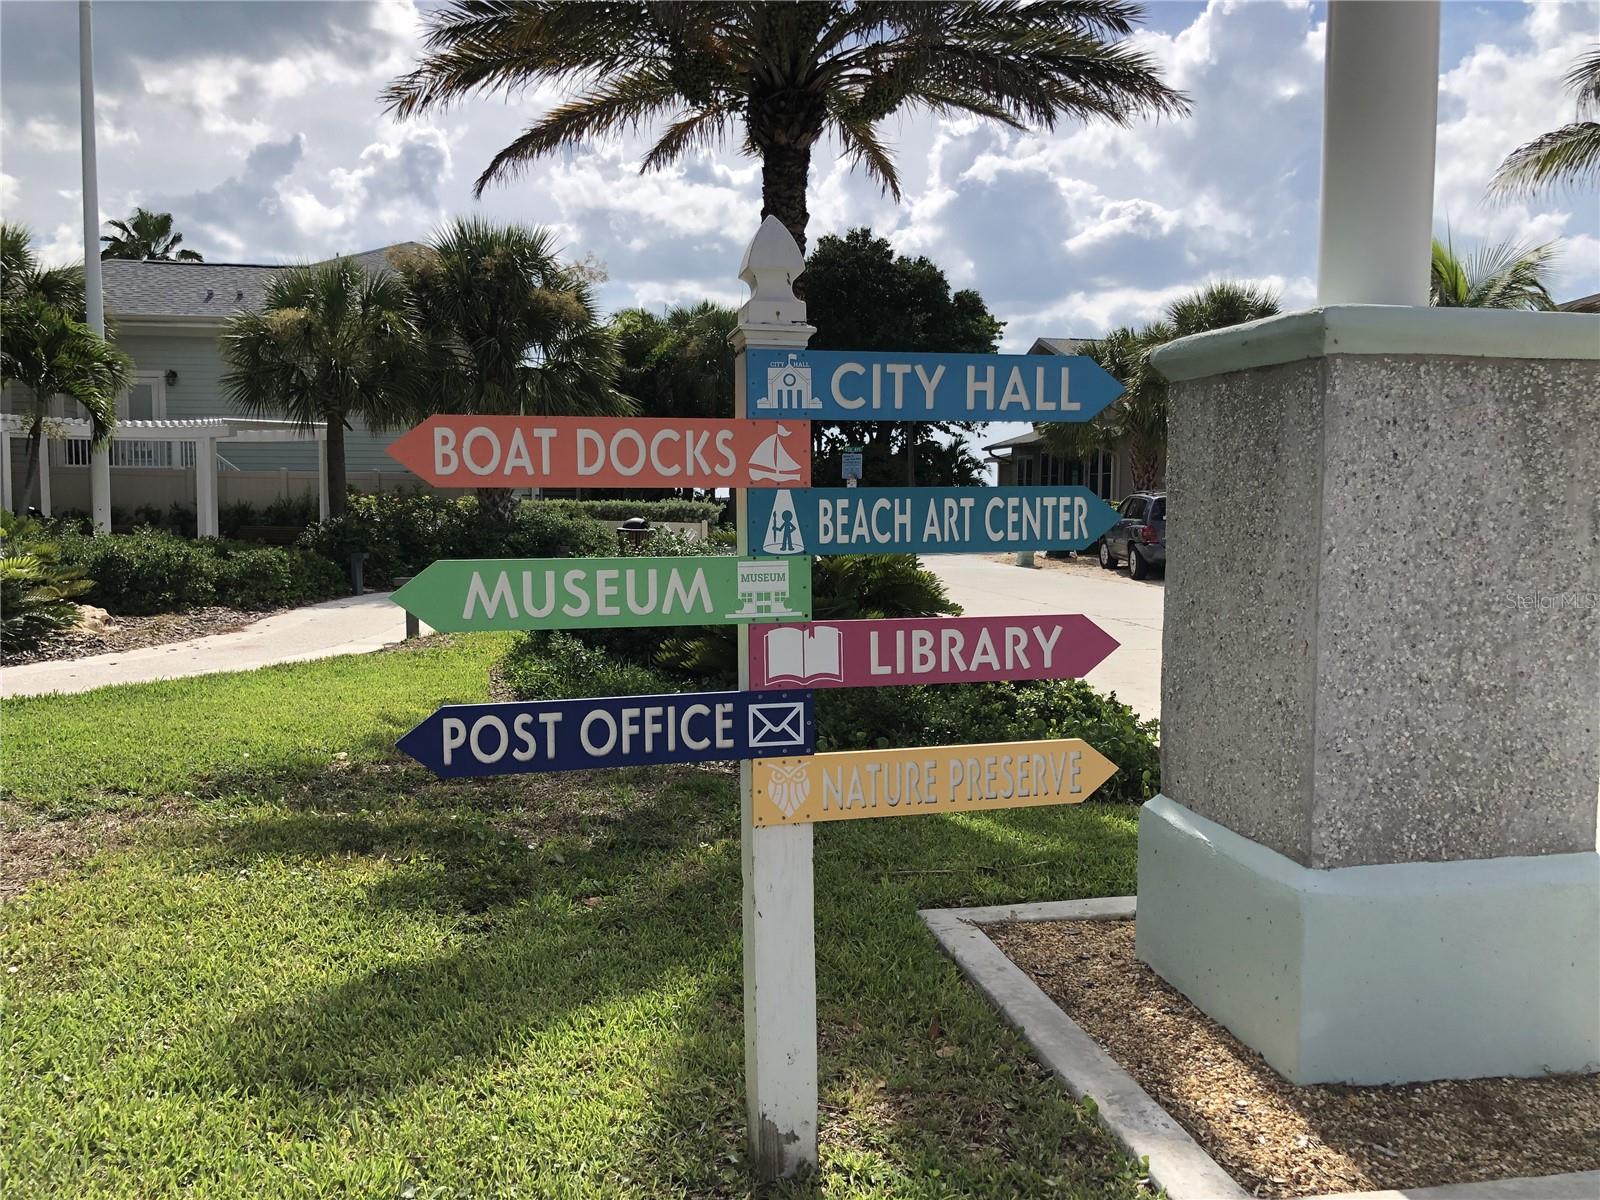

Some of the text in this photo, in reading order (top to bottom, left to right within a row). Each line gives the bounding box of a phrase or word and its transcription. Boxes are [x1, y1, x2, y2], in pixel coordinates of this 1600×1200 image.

[830, 362, 1081, 411] CITY HALL
[433, 426, 737, 477] BOAT DOCKS
[818, 496, 1089, 544] BEACH ART CENTER
[462, 567, 714, 620] MUSEUM
[741, 572, 786, 583] MUSEUM
[869, 625, 1063, 675] LIBRARY
[442, 703, 735, 766] POST OFFICE
[822, 750, 1082, 811] NATURE PRESERVE
